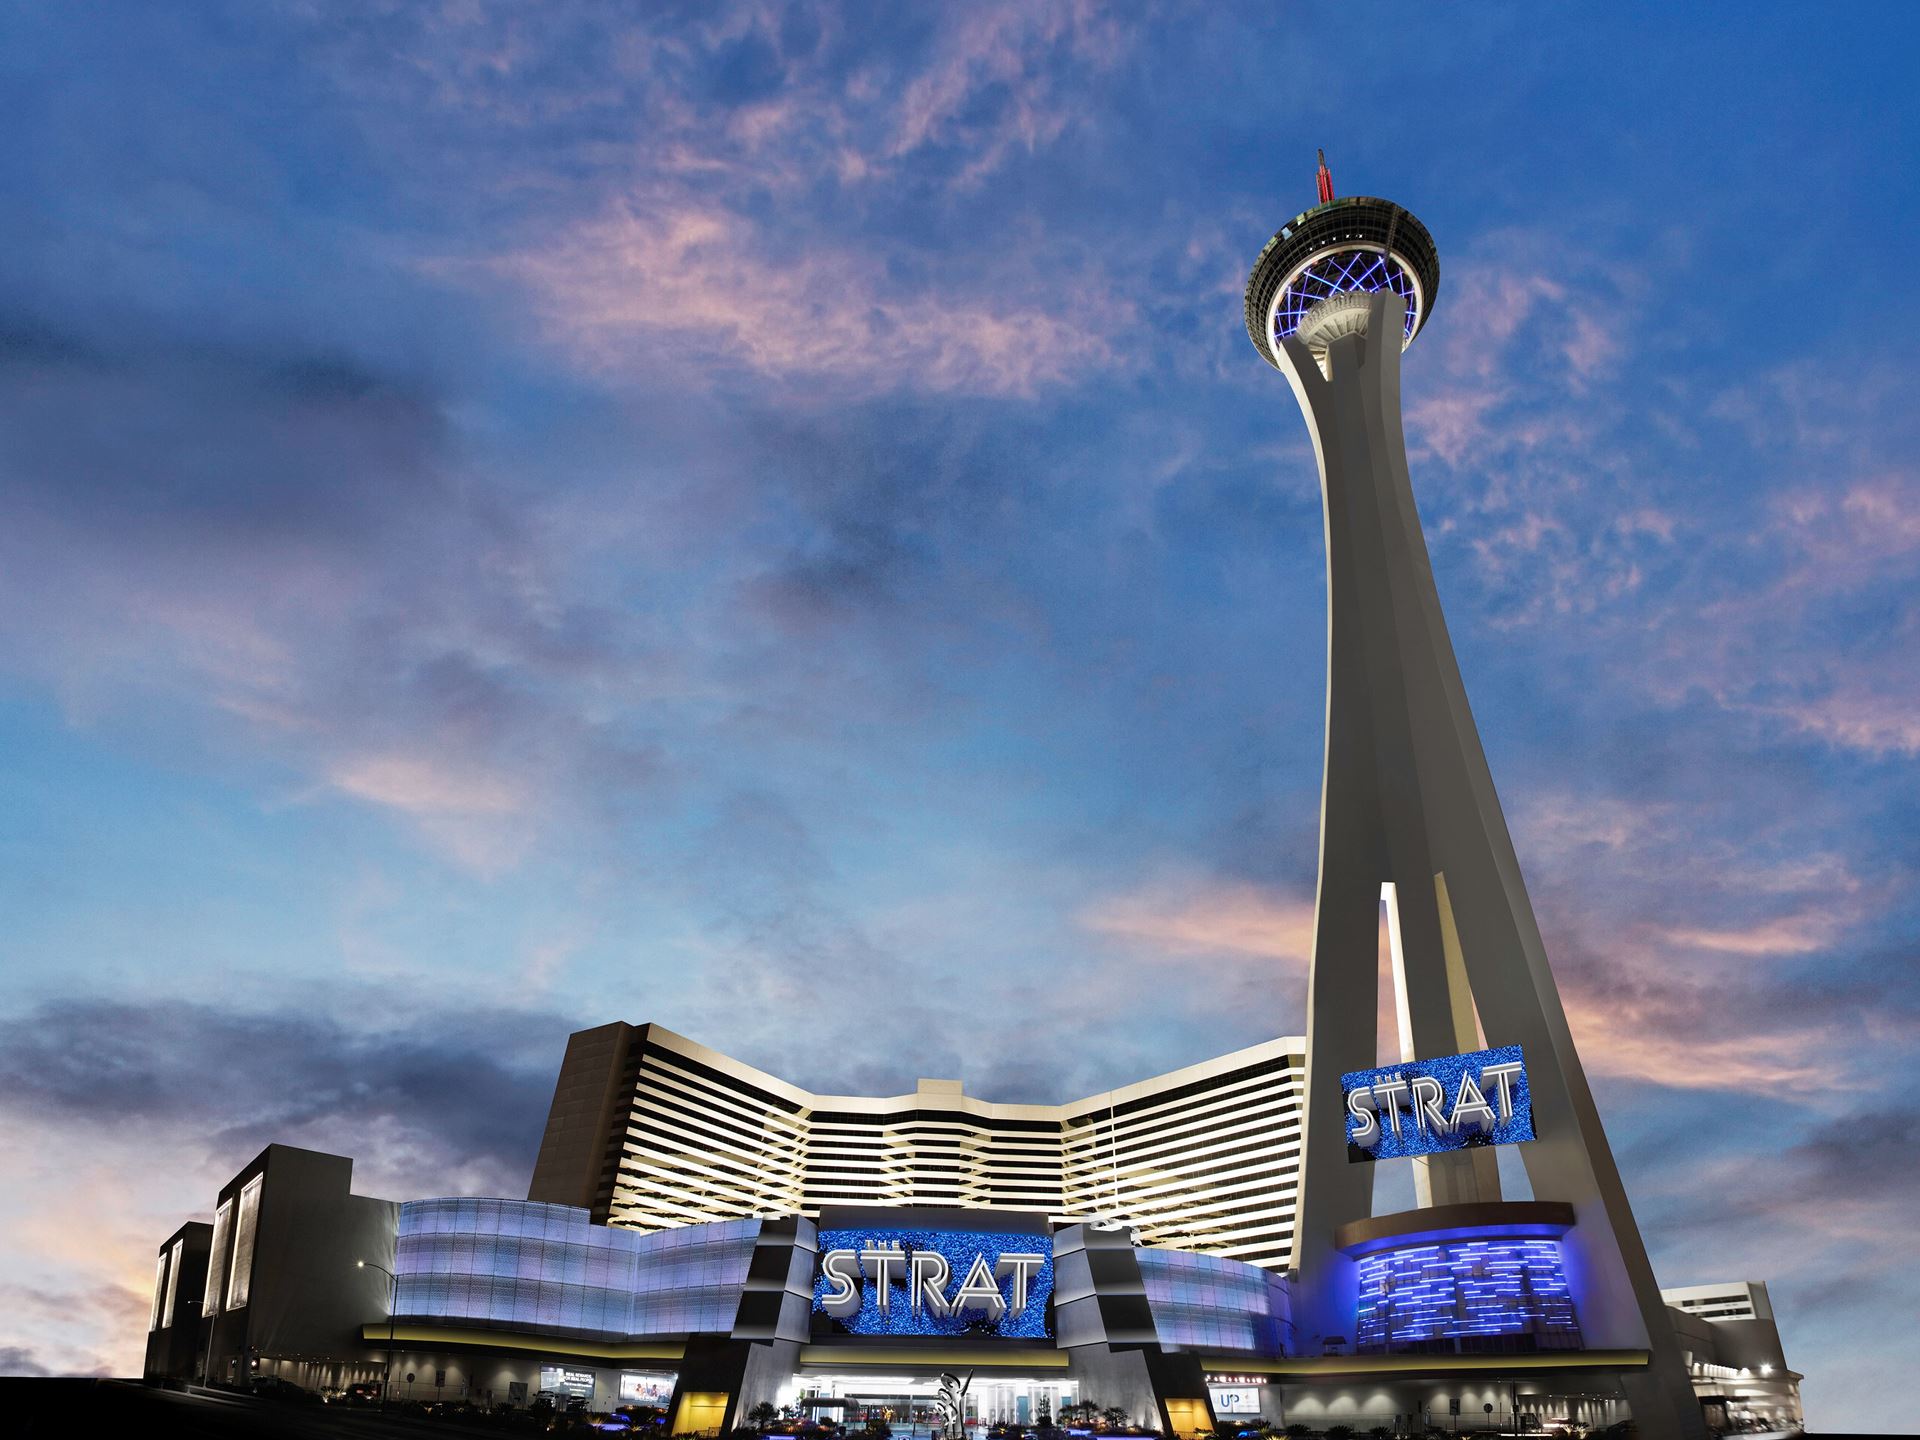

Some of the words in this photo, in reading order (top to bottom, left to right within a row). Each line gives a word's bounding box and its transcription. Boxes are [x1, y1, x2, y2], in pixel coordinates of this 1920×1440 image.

[1374, 1071, 1402, 1084] THE
[1347, 1061, 1523, 1140] STRAT
[865, 1239, 900, 1249] THE
[822, 1249, 1045, 1313] STRAT
